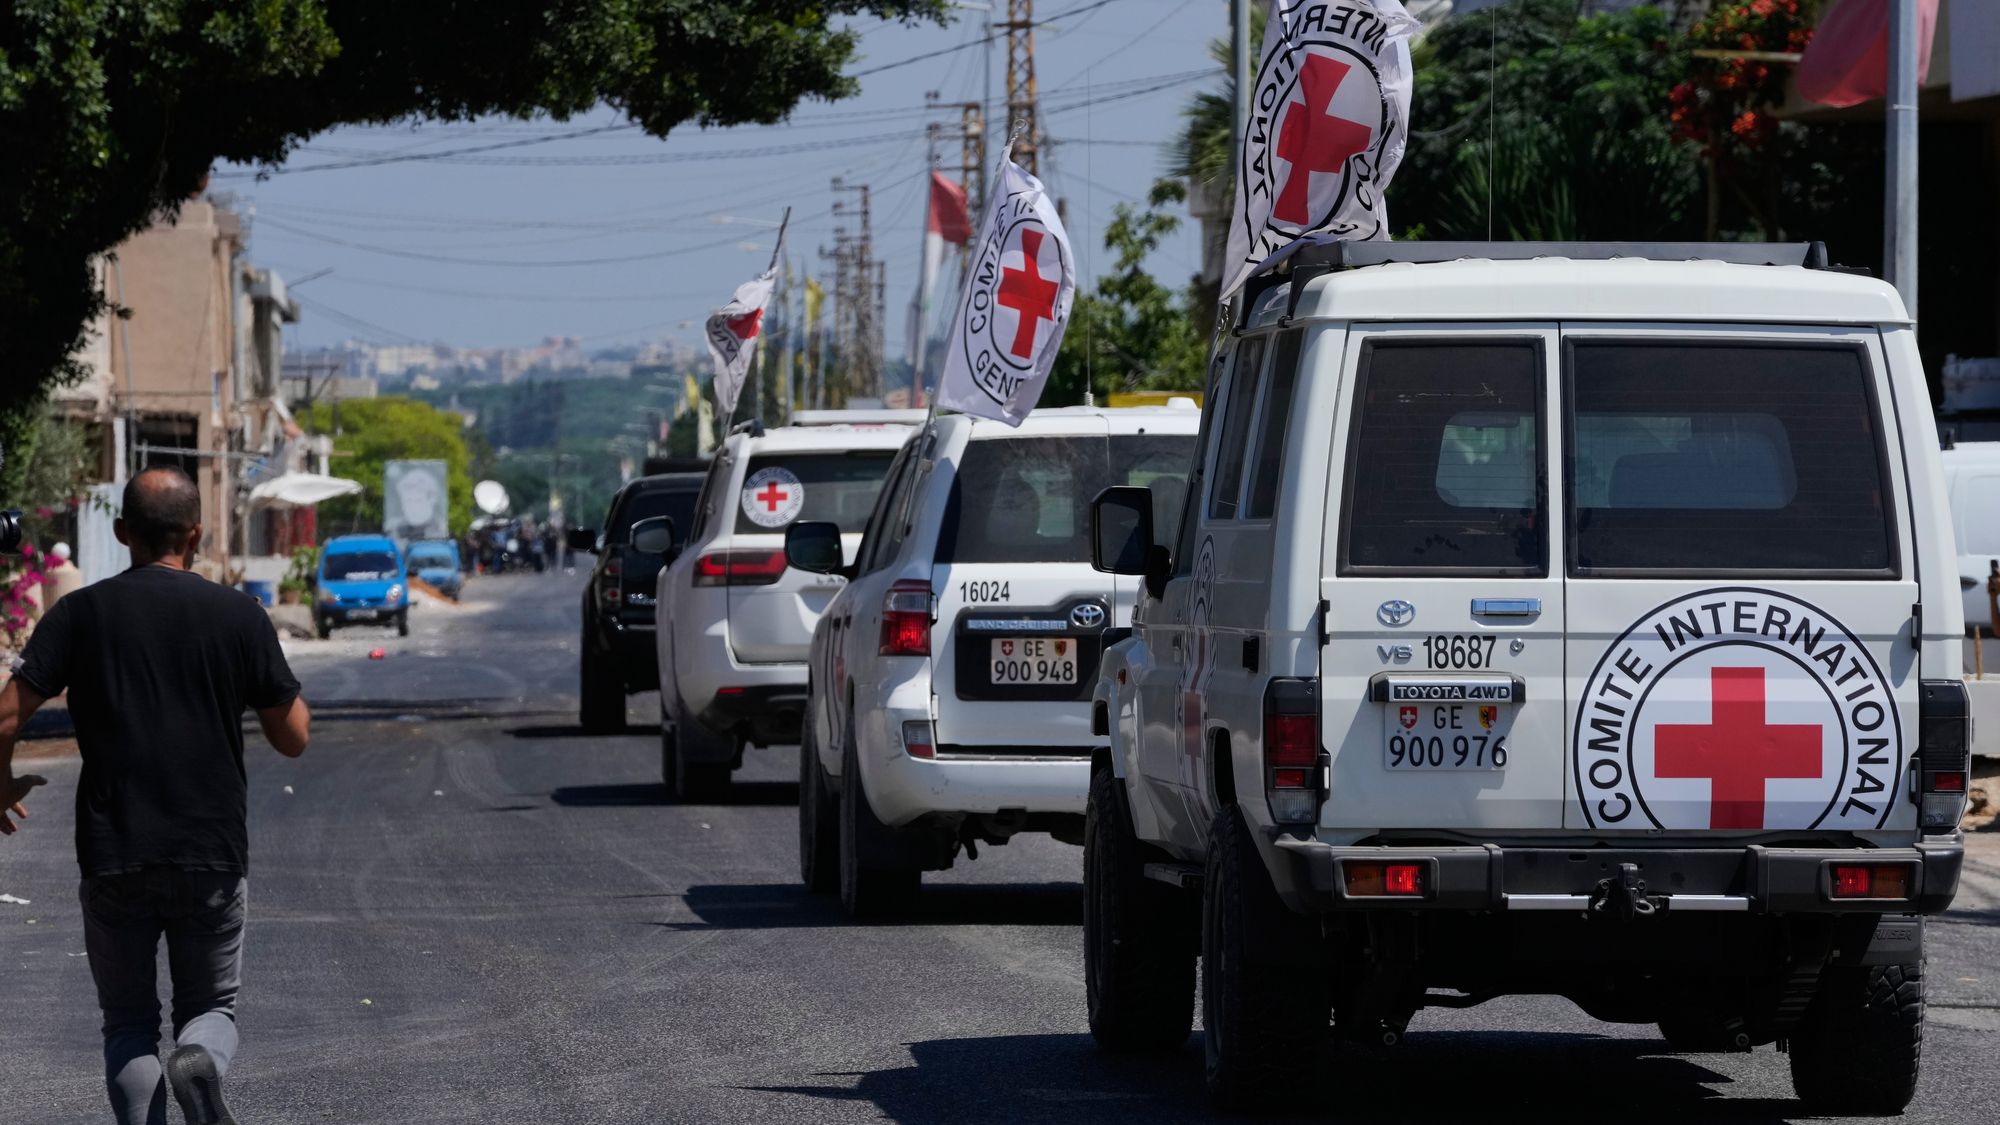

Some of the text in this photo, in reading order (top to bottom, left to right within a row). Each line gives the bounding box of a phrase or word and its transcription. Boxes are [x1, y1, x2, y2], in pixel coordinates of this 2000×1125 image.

[970, 213, 1005, 334] COMITE
[960, 581, 1010, 602] 16024
[967, 619, 1005, 630] LAND
[1024, 641, 1044, 657] GE
[1423, 635, 1497, 669] 18687
[994, 660, 1074, 682] 900 948
[1397, 686, 1510, 699] TOYOTA 4WD
[1433, 706, 1463, 730] GE
[1588, 601, 1889, 823] COMITE INTERNATIONAL
[1389, 736, 1507, 768] 900 976
[1872, 929, 1912, 941] RUISER
